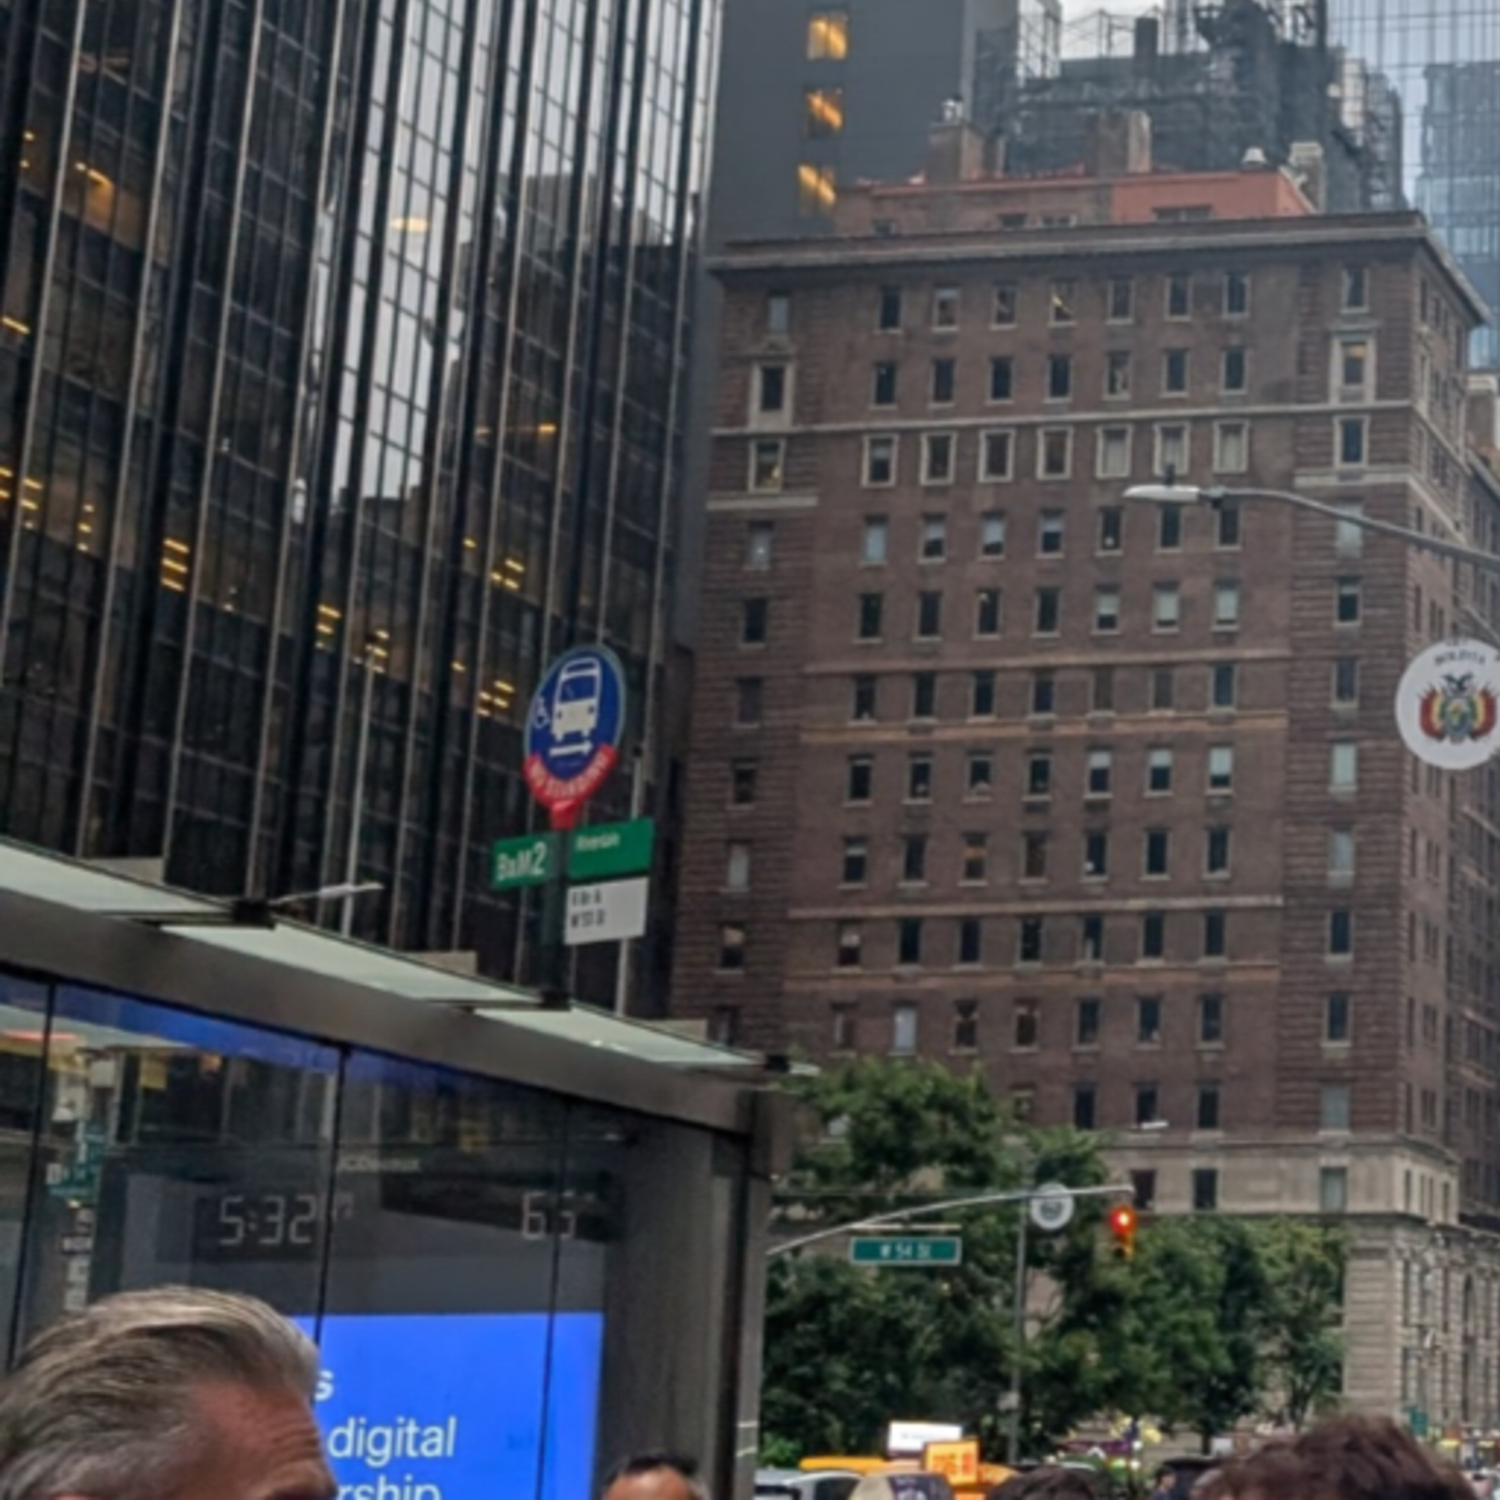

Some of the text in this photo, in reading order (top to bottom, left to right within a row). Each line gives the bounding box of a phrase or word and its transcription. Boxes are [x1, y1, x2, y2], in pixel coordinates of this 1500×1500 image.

[497, 841, 547, 881] BxM2
[219, 1195, 317, 1246] 5:32
[327, 1415, 457, 1468] digital
